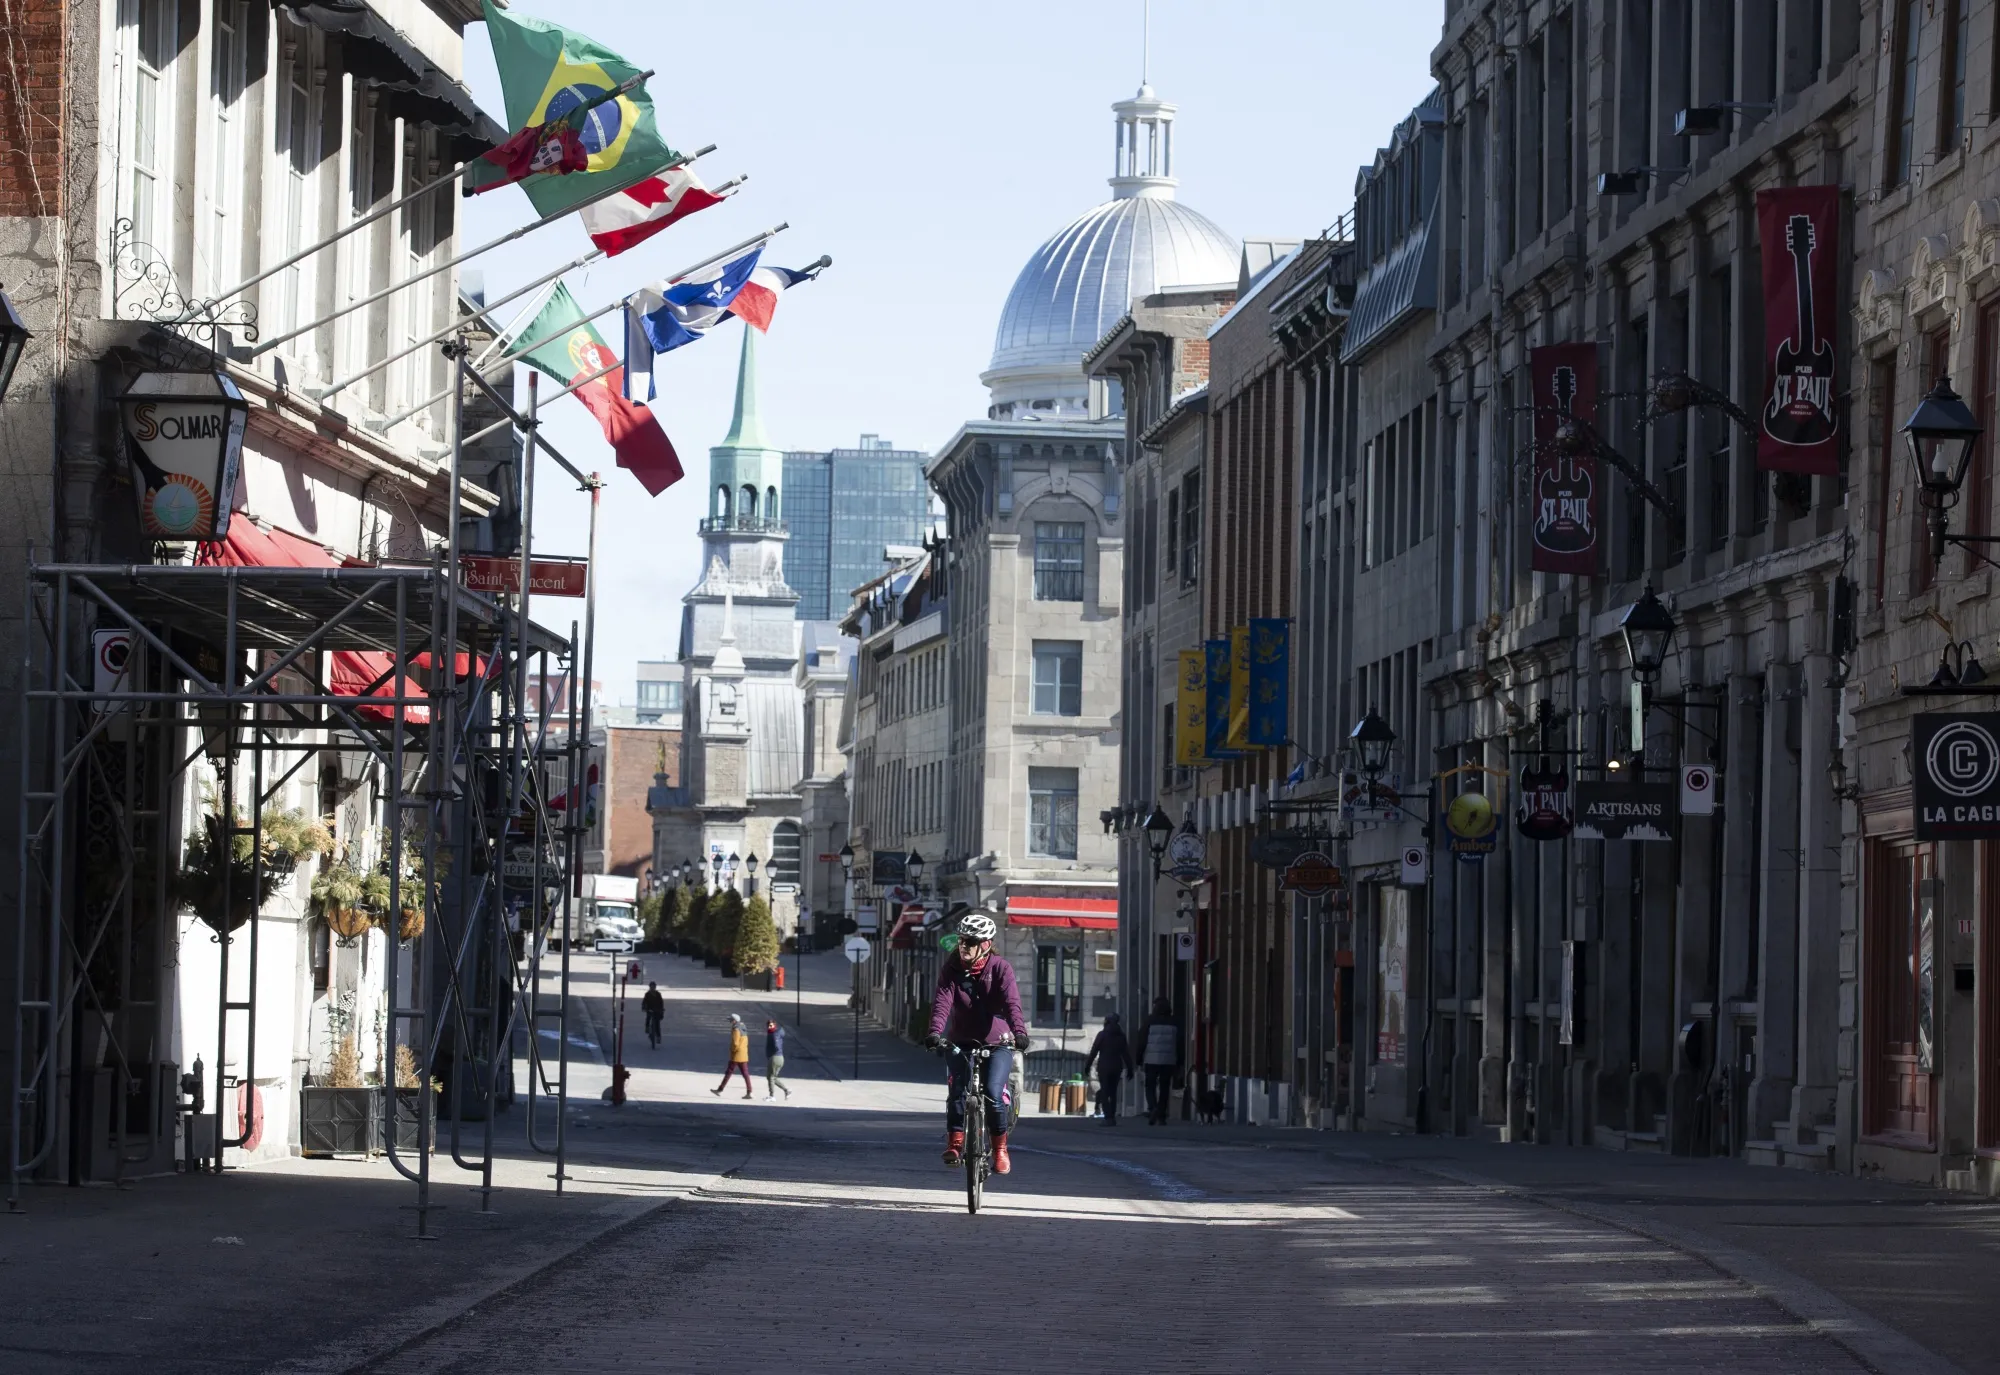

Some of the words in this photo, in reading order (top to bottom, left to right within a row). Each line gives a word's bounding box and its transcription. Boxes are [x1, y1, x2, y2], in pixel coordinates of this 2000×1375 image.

[1795, 365, 1813, 374] PUB
[1771, 374, 1793, 419] ST.
[1796, 375, 1832, 424] PAUL
[134, 402, 223, 442] SOLMAR
[1540, 498, 1558, 534] ST.
[1560, 498, 1591, 535] PAUL
[467, 570, 567, 590] Saint-Vncent
[1520, 792, 1538, 824] ST.
[1540, 791, 1571, 824] PAUL
[1586, 802, 1662, 818] ARTISANS
[1923, 806, 1948, 823] LA
[1450, 838, 1493, 852] Amber
[1959, 920, 1974, 933] 11
